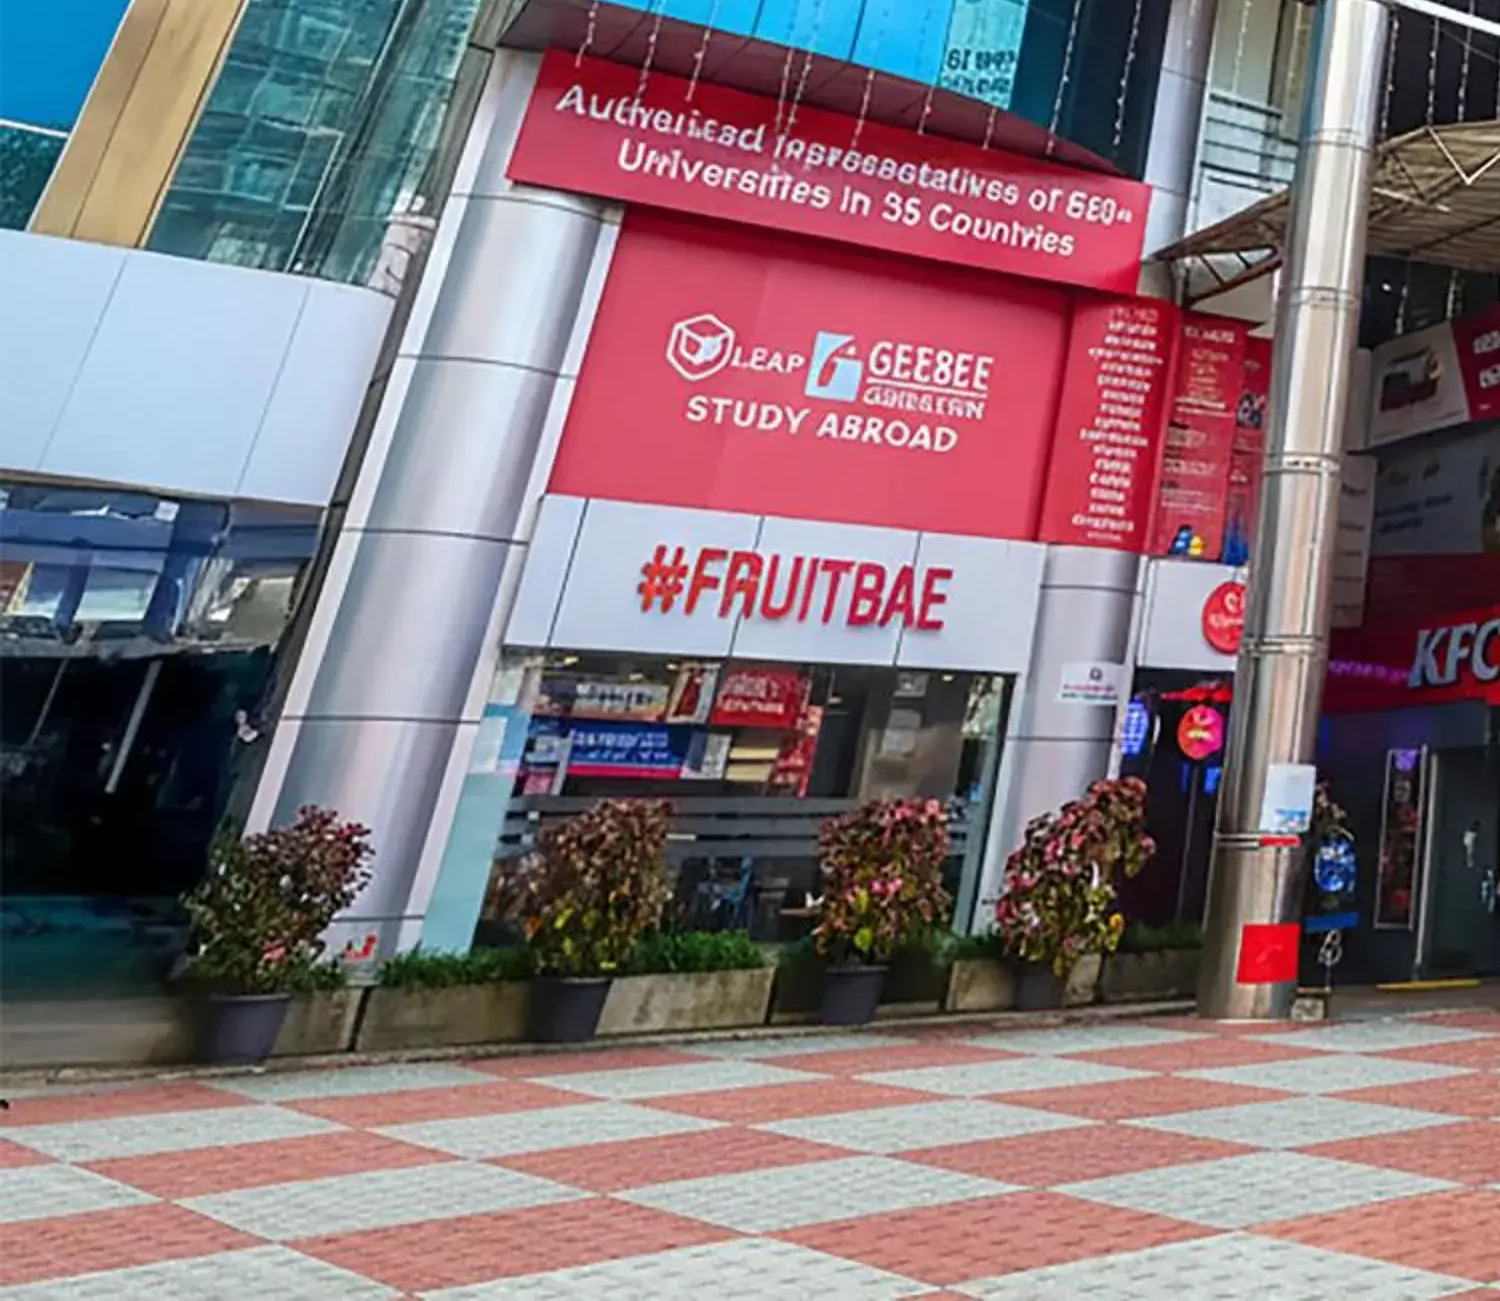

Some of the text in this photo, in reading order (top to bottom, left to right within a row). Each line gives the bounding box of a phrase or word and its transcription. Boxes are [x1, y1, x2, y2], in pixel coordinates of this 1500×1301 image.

[929, 203, 1075, 257] Countries
[731, 345, 806, 374] LEAP
[686, 394, 958, 453] STUDY ABROAD
[636, 544, 953, 632] #FRUITBAE
